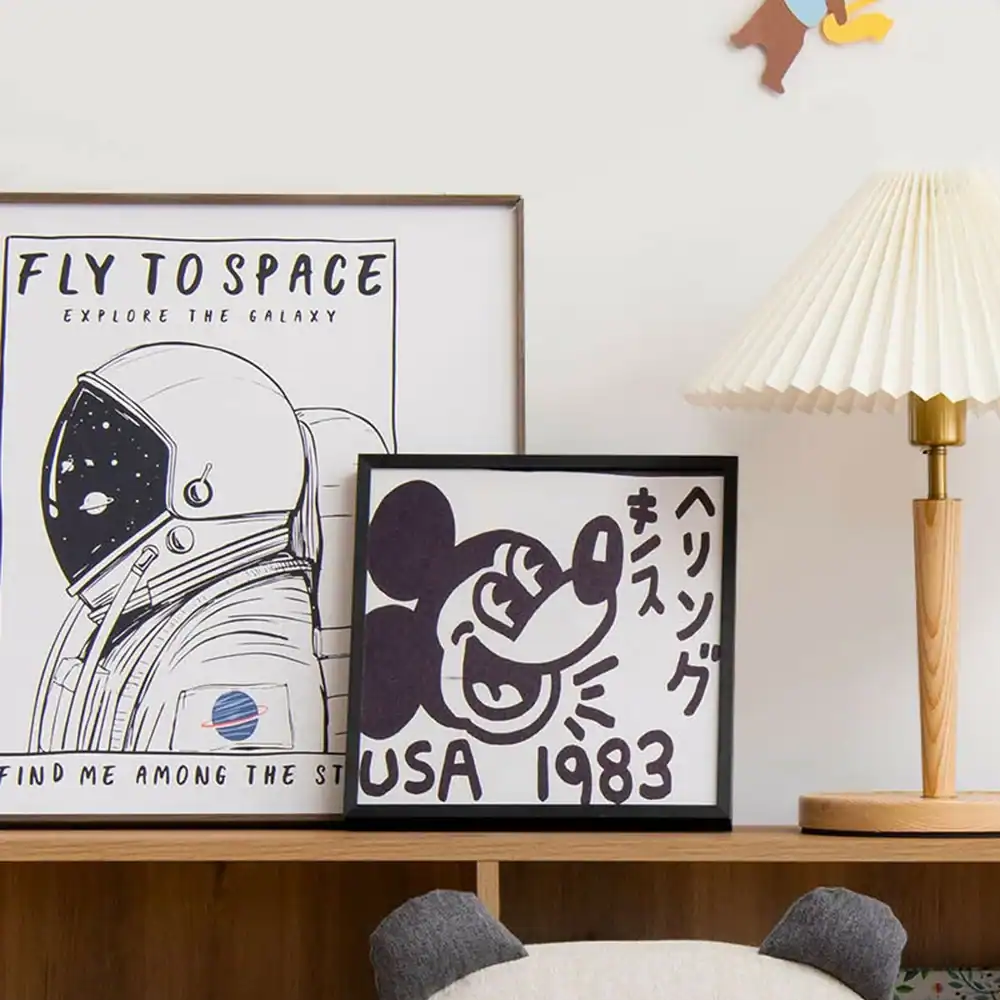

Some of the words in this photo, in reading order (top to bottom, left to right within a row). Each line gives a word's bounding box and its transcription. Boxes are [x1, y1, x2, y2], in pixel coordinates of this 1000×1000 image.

[17, 252, 115, 296] FLY
[141, 252, 203, 296] TO
[223, 252, 387, 296] SPACE
[63, 309, 168, 323] EXPLORE
[189, 309, 230, 323] THE
[249, 309, 338, 323] GALAXY
[0, 762, 64, 786] FIND
[79, 764, 116, 786] ME
[135, 764, 227, 786] AMONG
[246, 764, 297, 786] THE
[359, 738, 484, 803] USA
[537, 729, 675, 805] 1983
